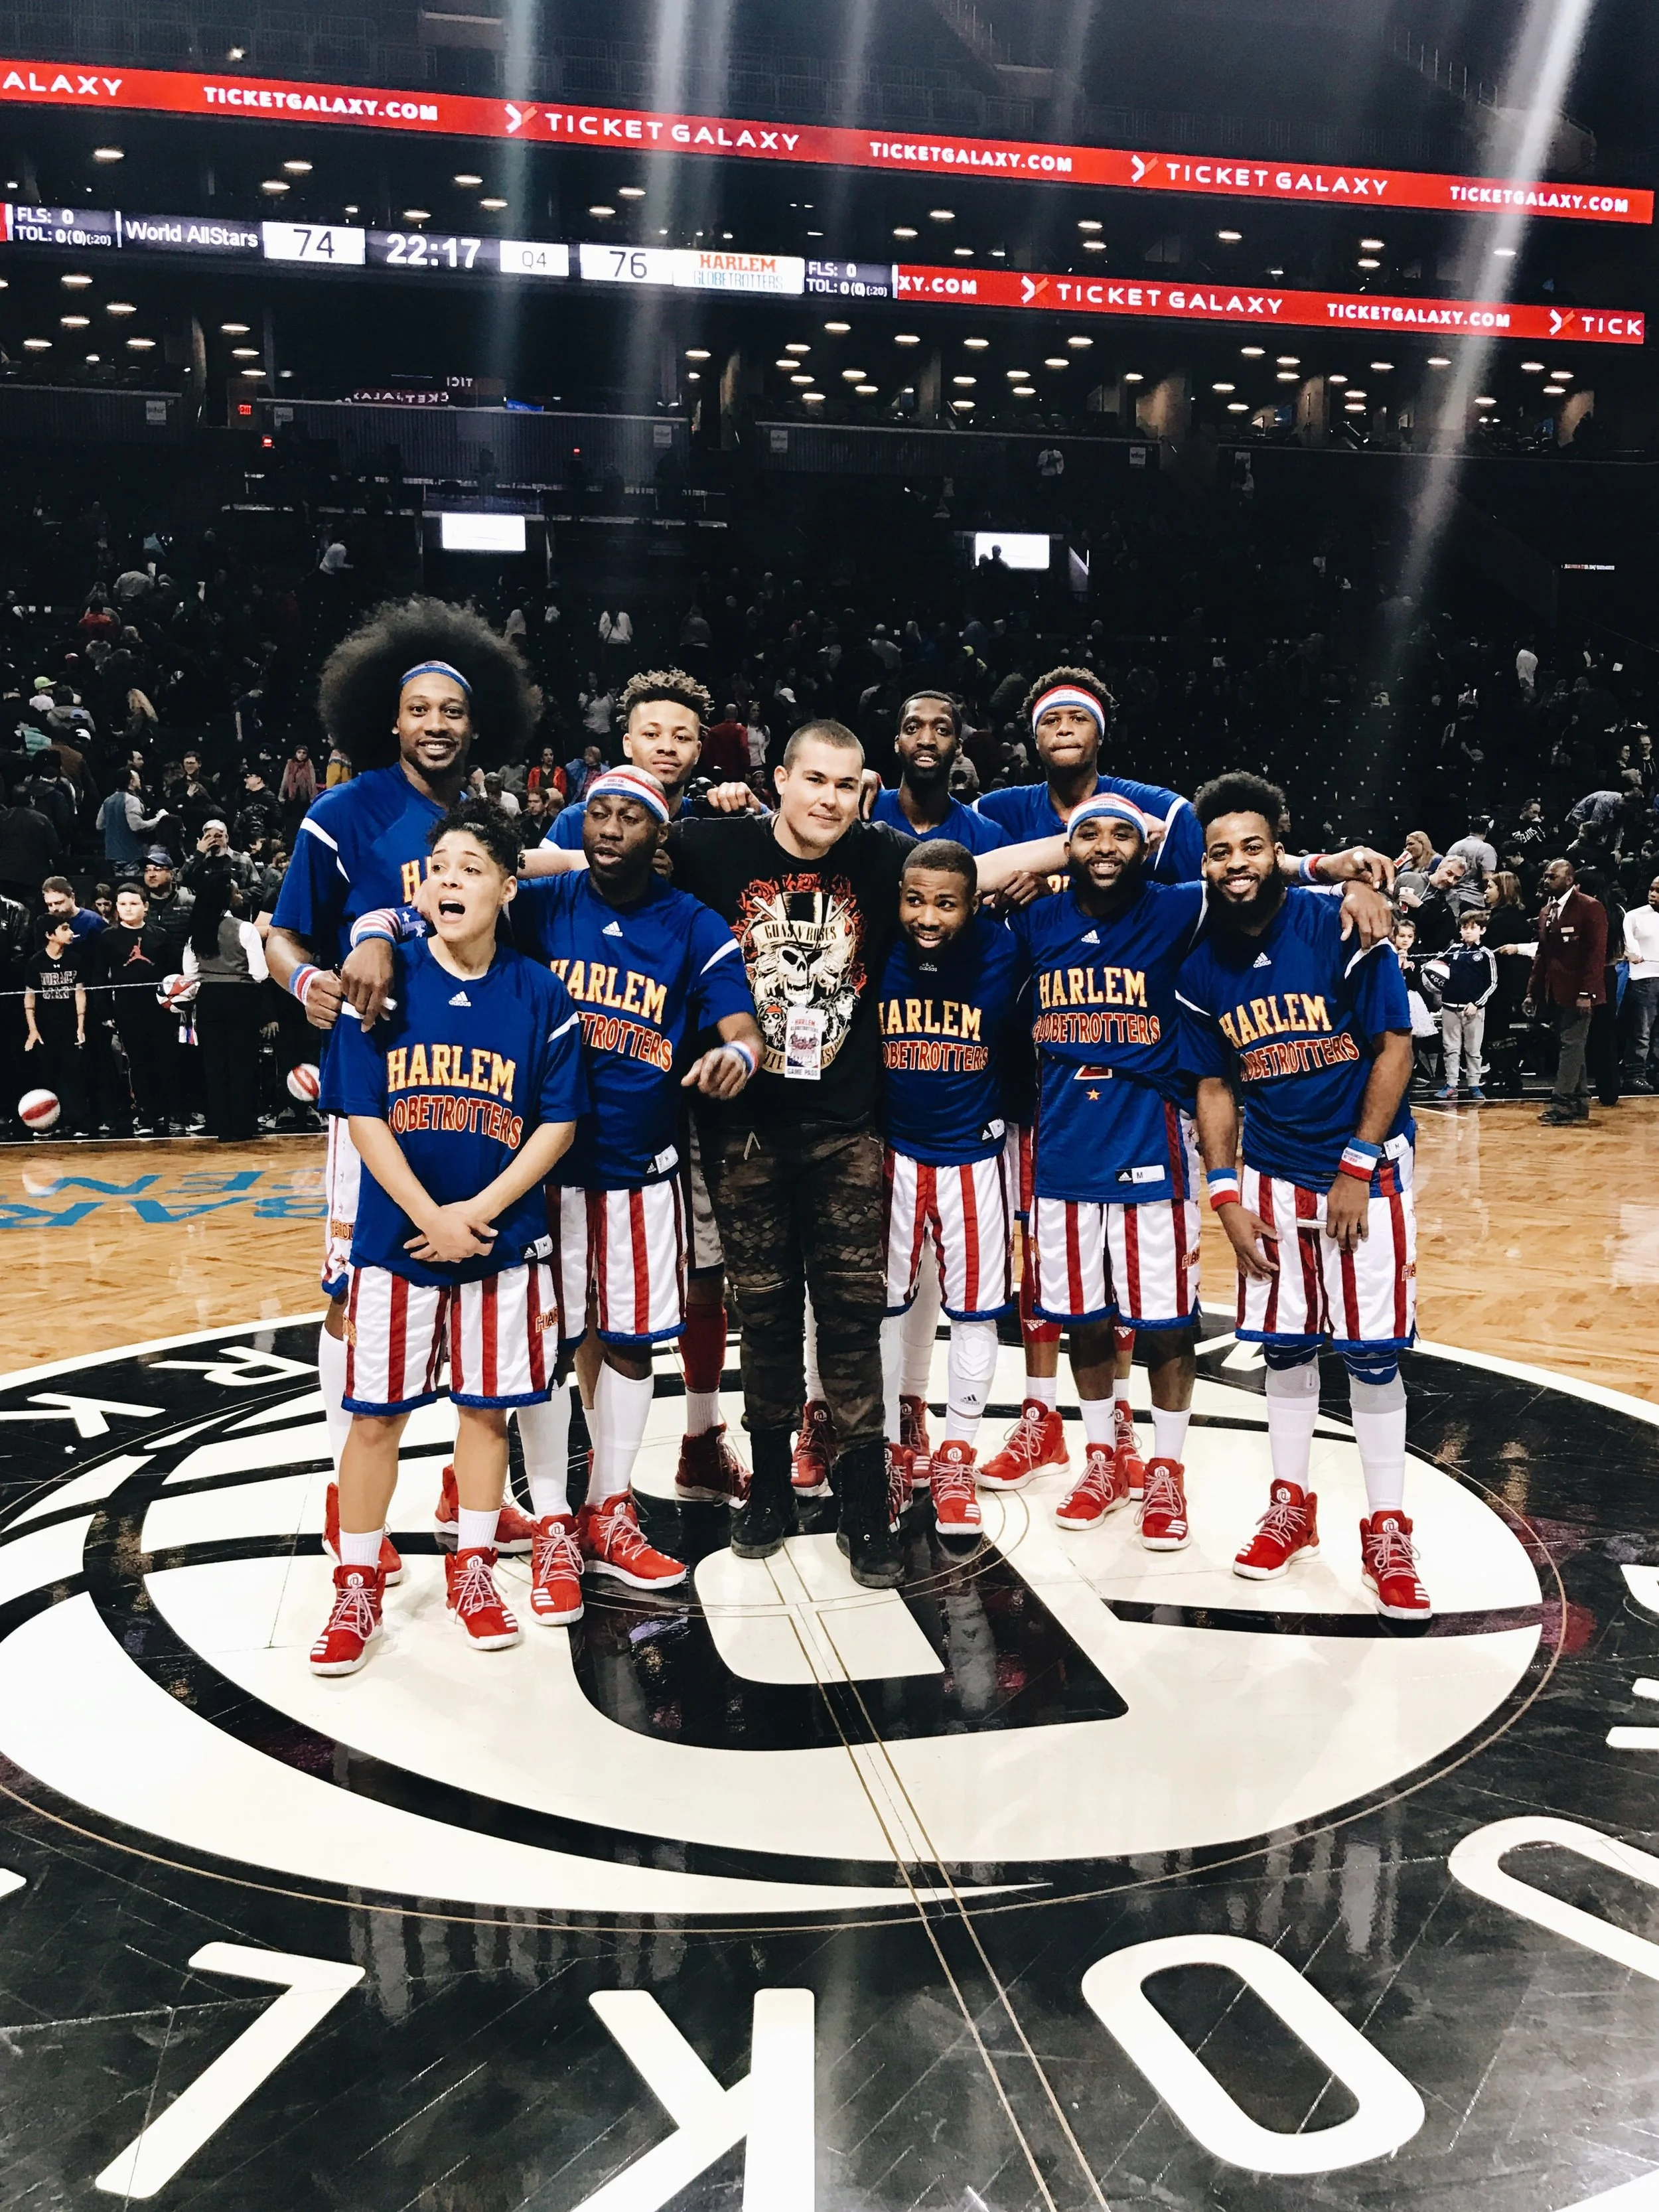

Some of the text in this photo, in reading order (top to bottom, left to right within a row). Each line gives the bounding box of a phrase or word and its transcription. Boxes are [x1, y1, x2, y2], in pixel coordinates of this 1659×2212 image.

[3, 70, 122, 96] ALAXY
[204, 86, 438, 121] TICKETGALAXY.COM
[545, 113, 799, 151] TICKET GALAXY
[869, 141, 1072, 172] TICKETGALAXY.COM
[1166, 163, 1388, 195] TICKET GALAXY
[1450, 186, 1628, 213] TICKETGALAXY.COM
[17, 206, 52, 224] FLS:
[15, 226, 52, 242] TOL:
[125, 220, 259, 248] World AllStars
[292, 228, 335, 259] 74
[386, 234, 481, 268] 22:17
[522, 250, 547, 269] Q4
[609, 250, 648, 279] 76
[699, 254, 776, 273] HARLEM
[693, 271, 784, 291] GLOBETROTTERS
[808, 261, 838, 277] FLS:
[806, 278, 837, 293] TOL:
[899, 275, 977, 295] XY.COM
[1057, 283, 1283, 315] TICKET GALAXY
[1327, 303, 1510, 327] TICKETGALAXY.COM
[1581, 317, 1642, 336] TICK
[764, 923, 793, 939] GUNS
[1039, 966, 1149, 1010] HARLEM
[1218, 994, 1333, 1049] HARLEM
[577, 1011, 673, 1073] TROTTERS
[882, 1040, 989, 1072] OBETROTTERS
[387, 1043, 518, 1104] HARLEM
